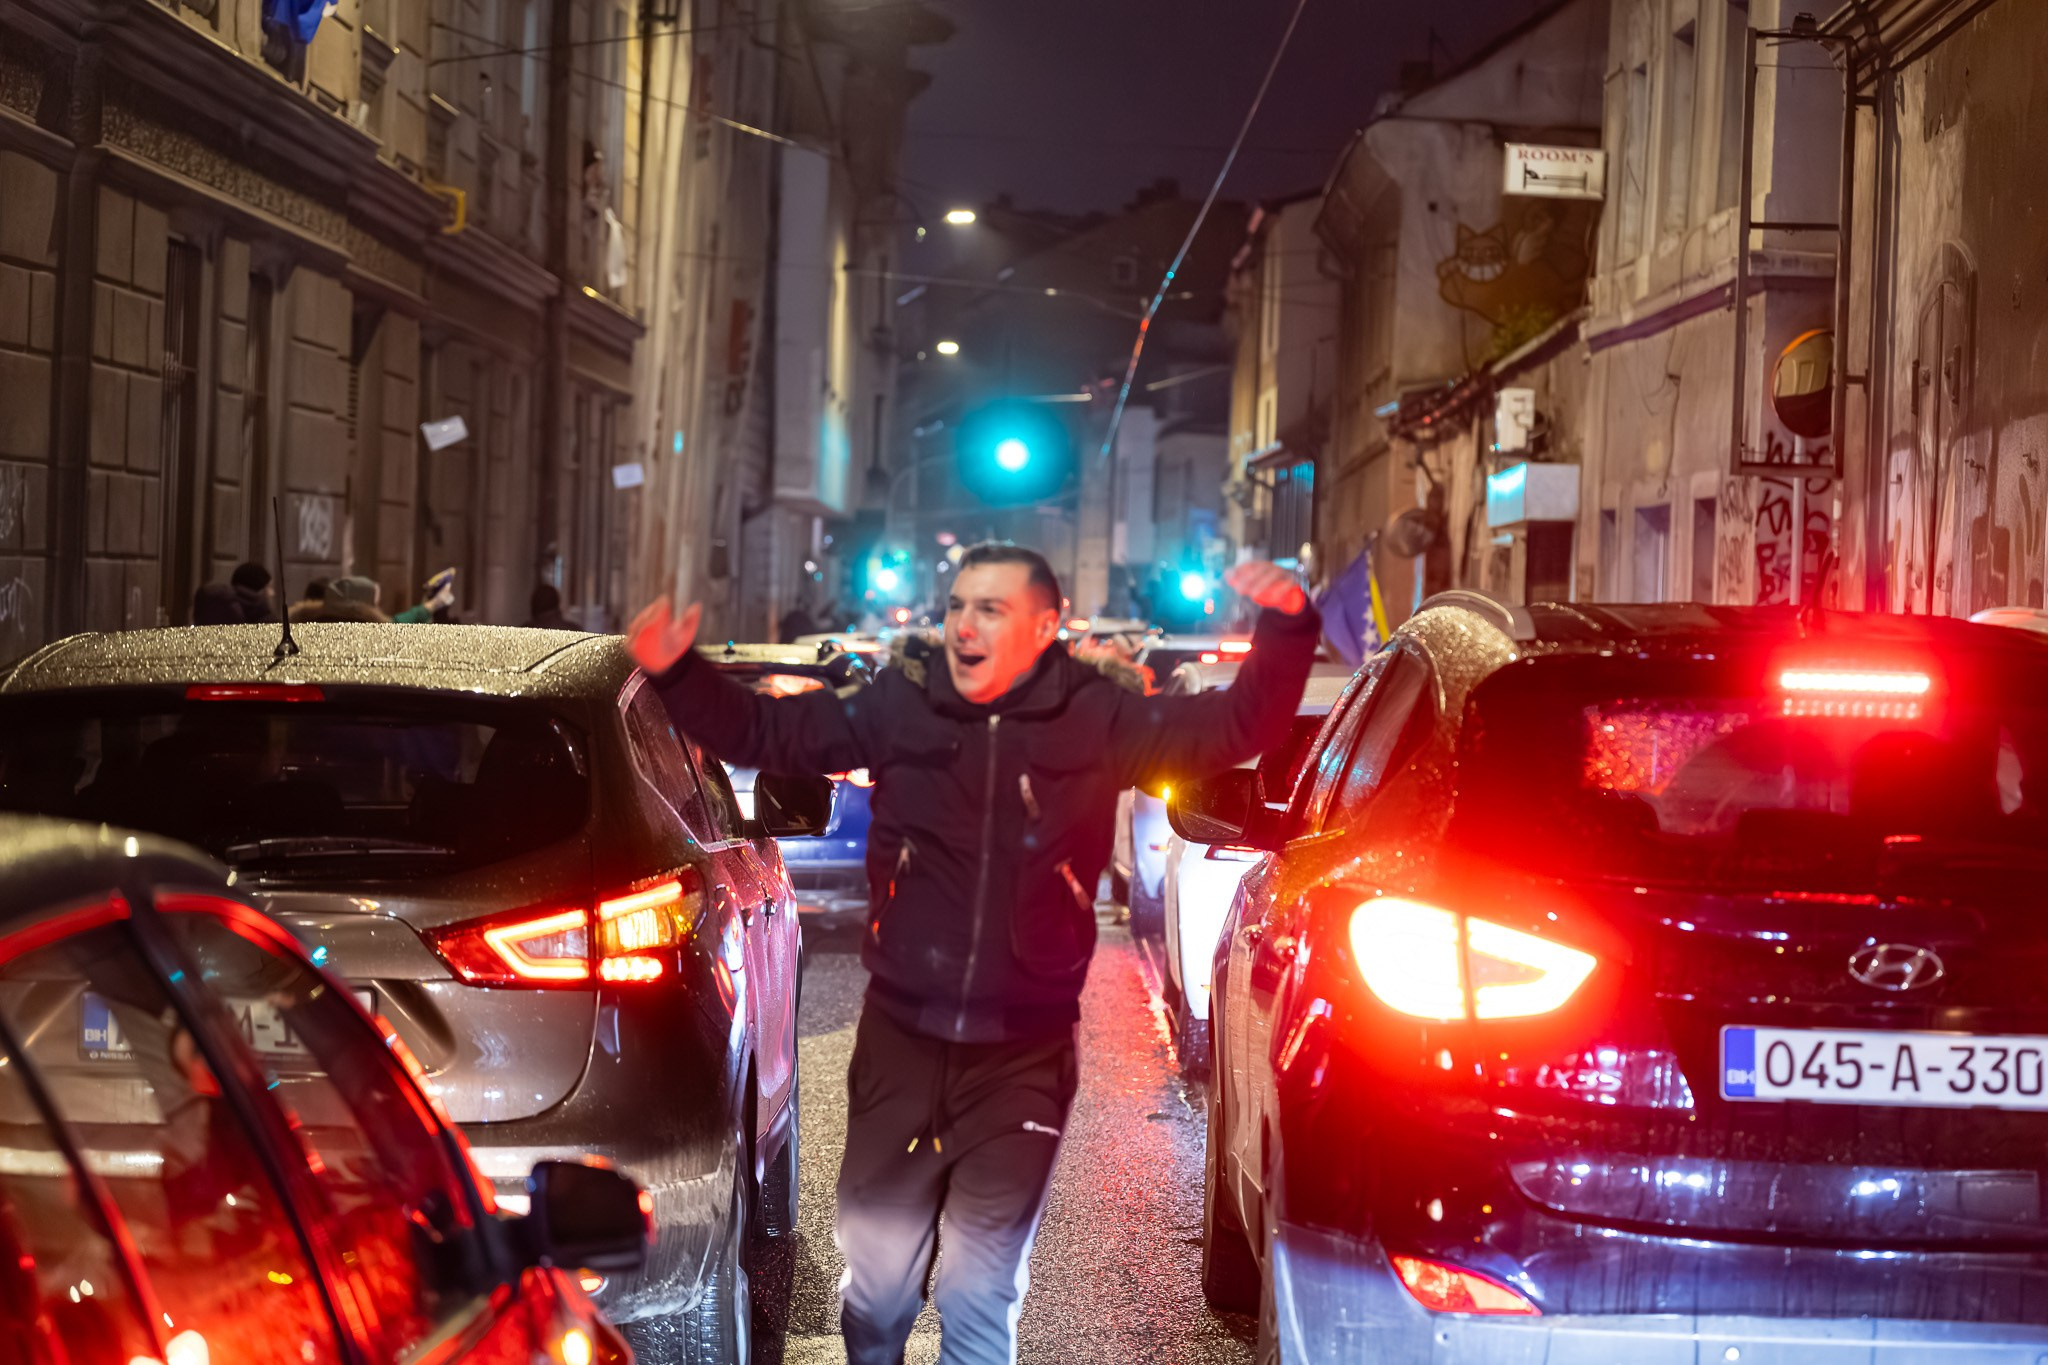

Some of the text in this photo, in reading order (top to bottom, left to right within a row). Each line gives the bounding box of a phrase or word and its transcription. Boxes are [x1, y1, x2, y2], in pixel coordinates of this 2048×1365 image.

[1518, 147, 1594, 165] ROOM'S
[84, 1028, 107, 1042] BIH
[1764, 1039, 2044, 1096] 045-A-330
